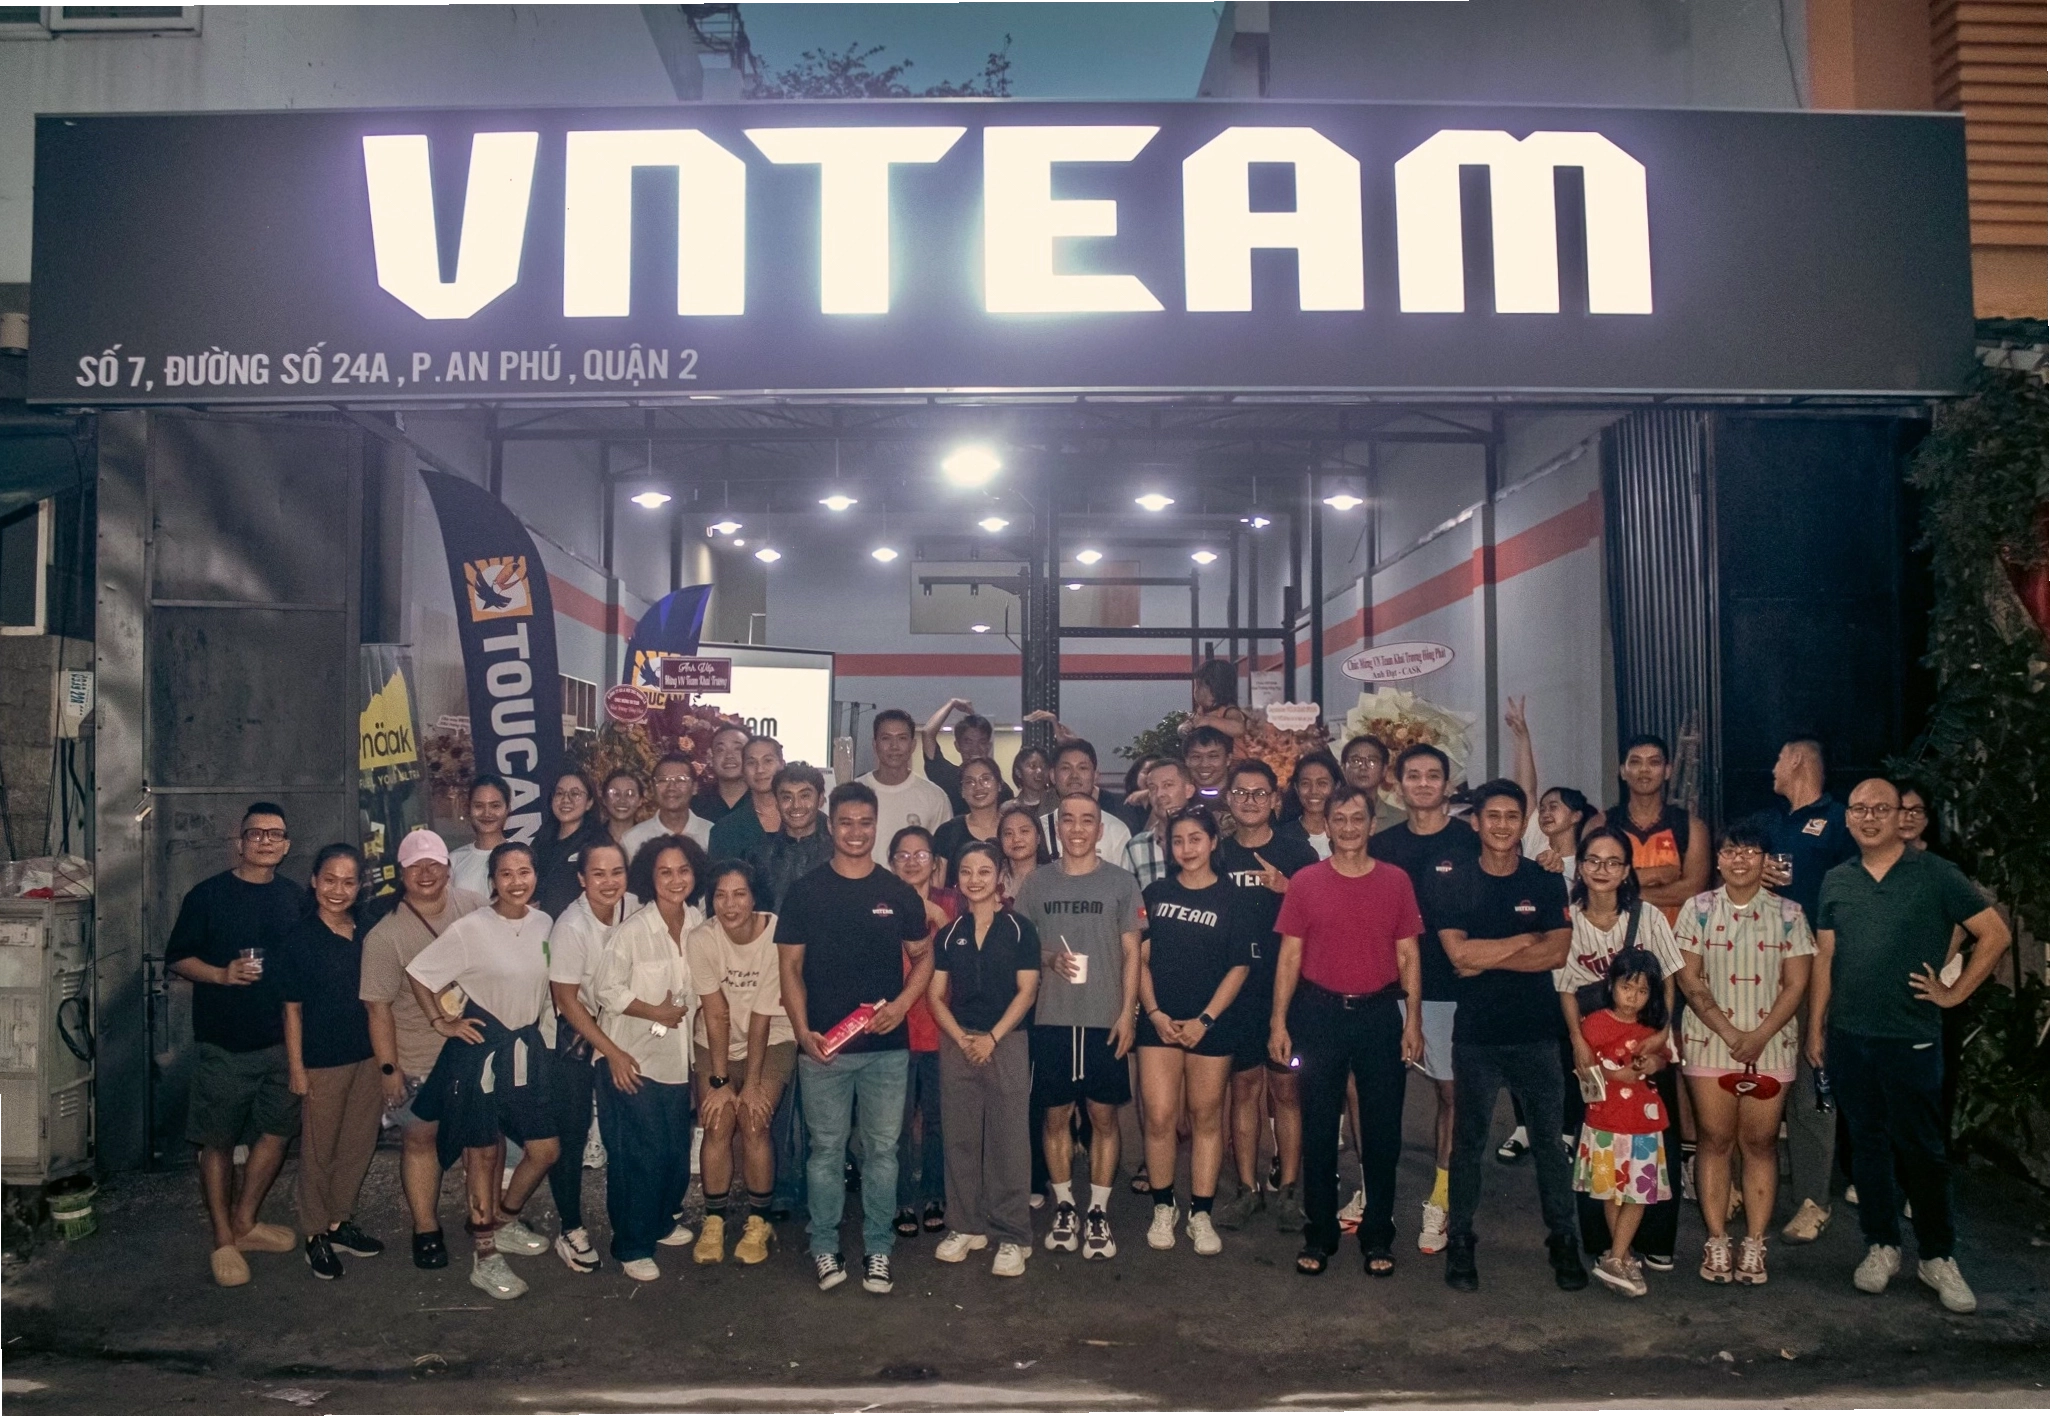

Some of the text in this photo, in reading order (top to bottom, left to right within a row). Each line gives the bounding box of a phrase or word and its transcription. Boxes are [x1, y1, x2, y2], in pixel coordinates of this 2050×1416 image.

[362, 125, 1653, 320] VNTEAM
[76, 344, 122, 387] SỐ
[128, 356, 154, 391] 7,
[164, 345, 270, 386] ĐƯỜNG
[280, 342, 327, 385] SỐ
[583, 342, 669, 387] QUẬN
[678, 348, 699, 380] 2
[361, 721, 413, 760] näak
[1043, 900, 1104, 915] VNTEAM
[1154, 901, 1218, 928] NTEAM
